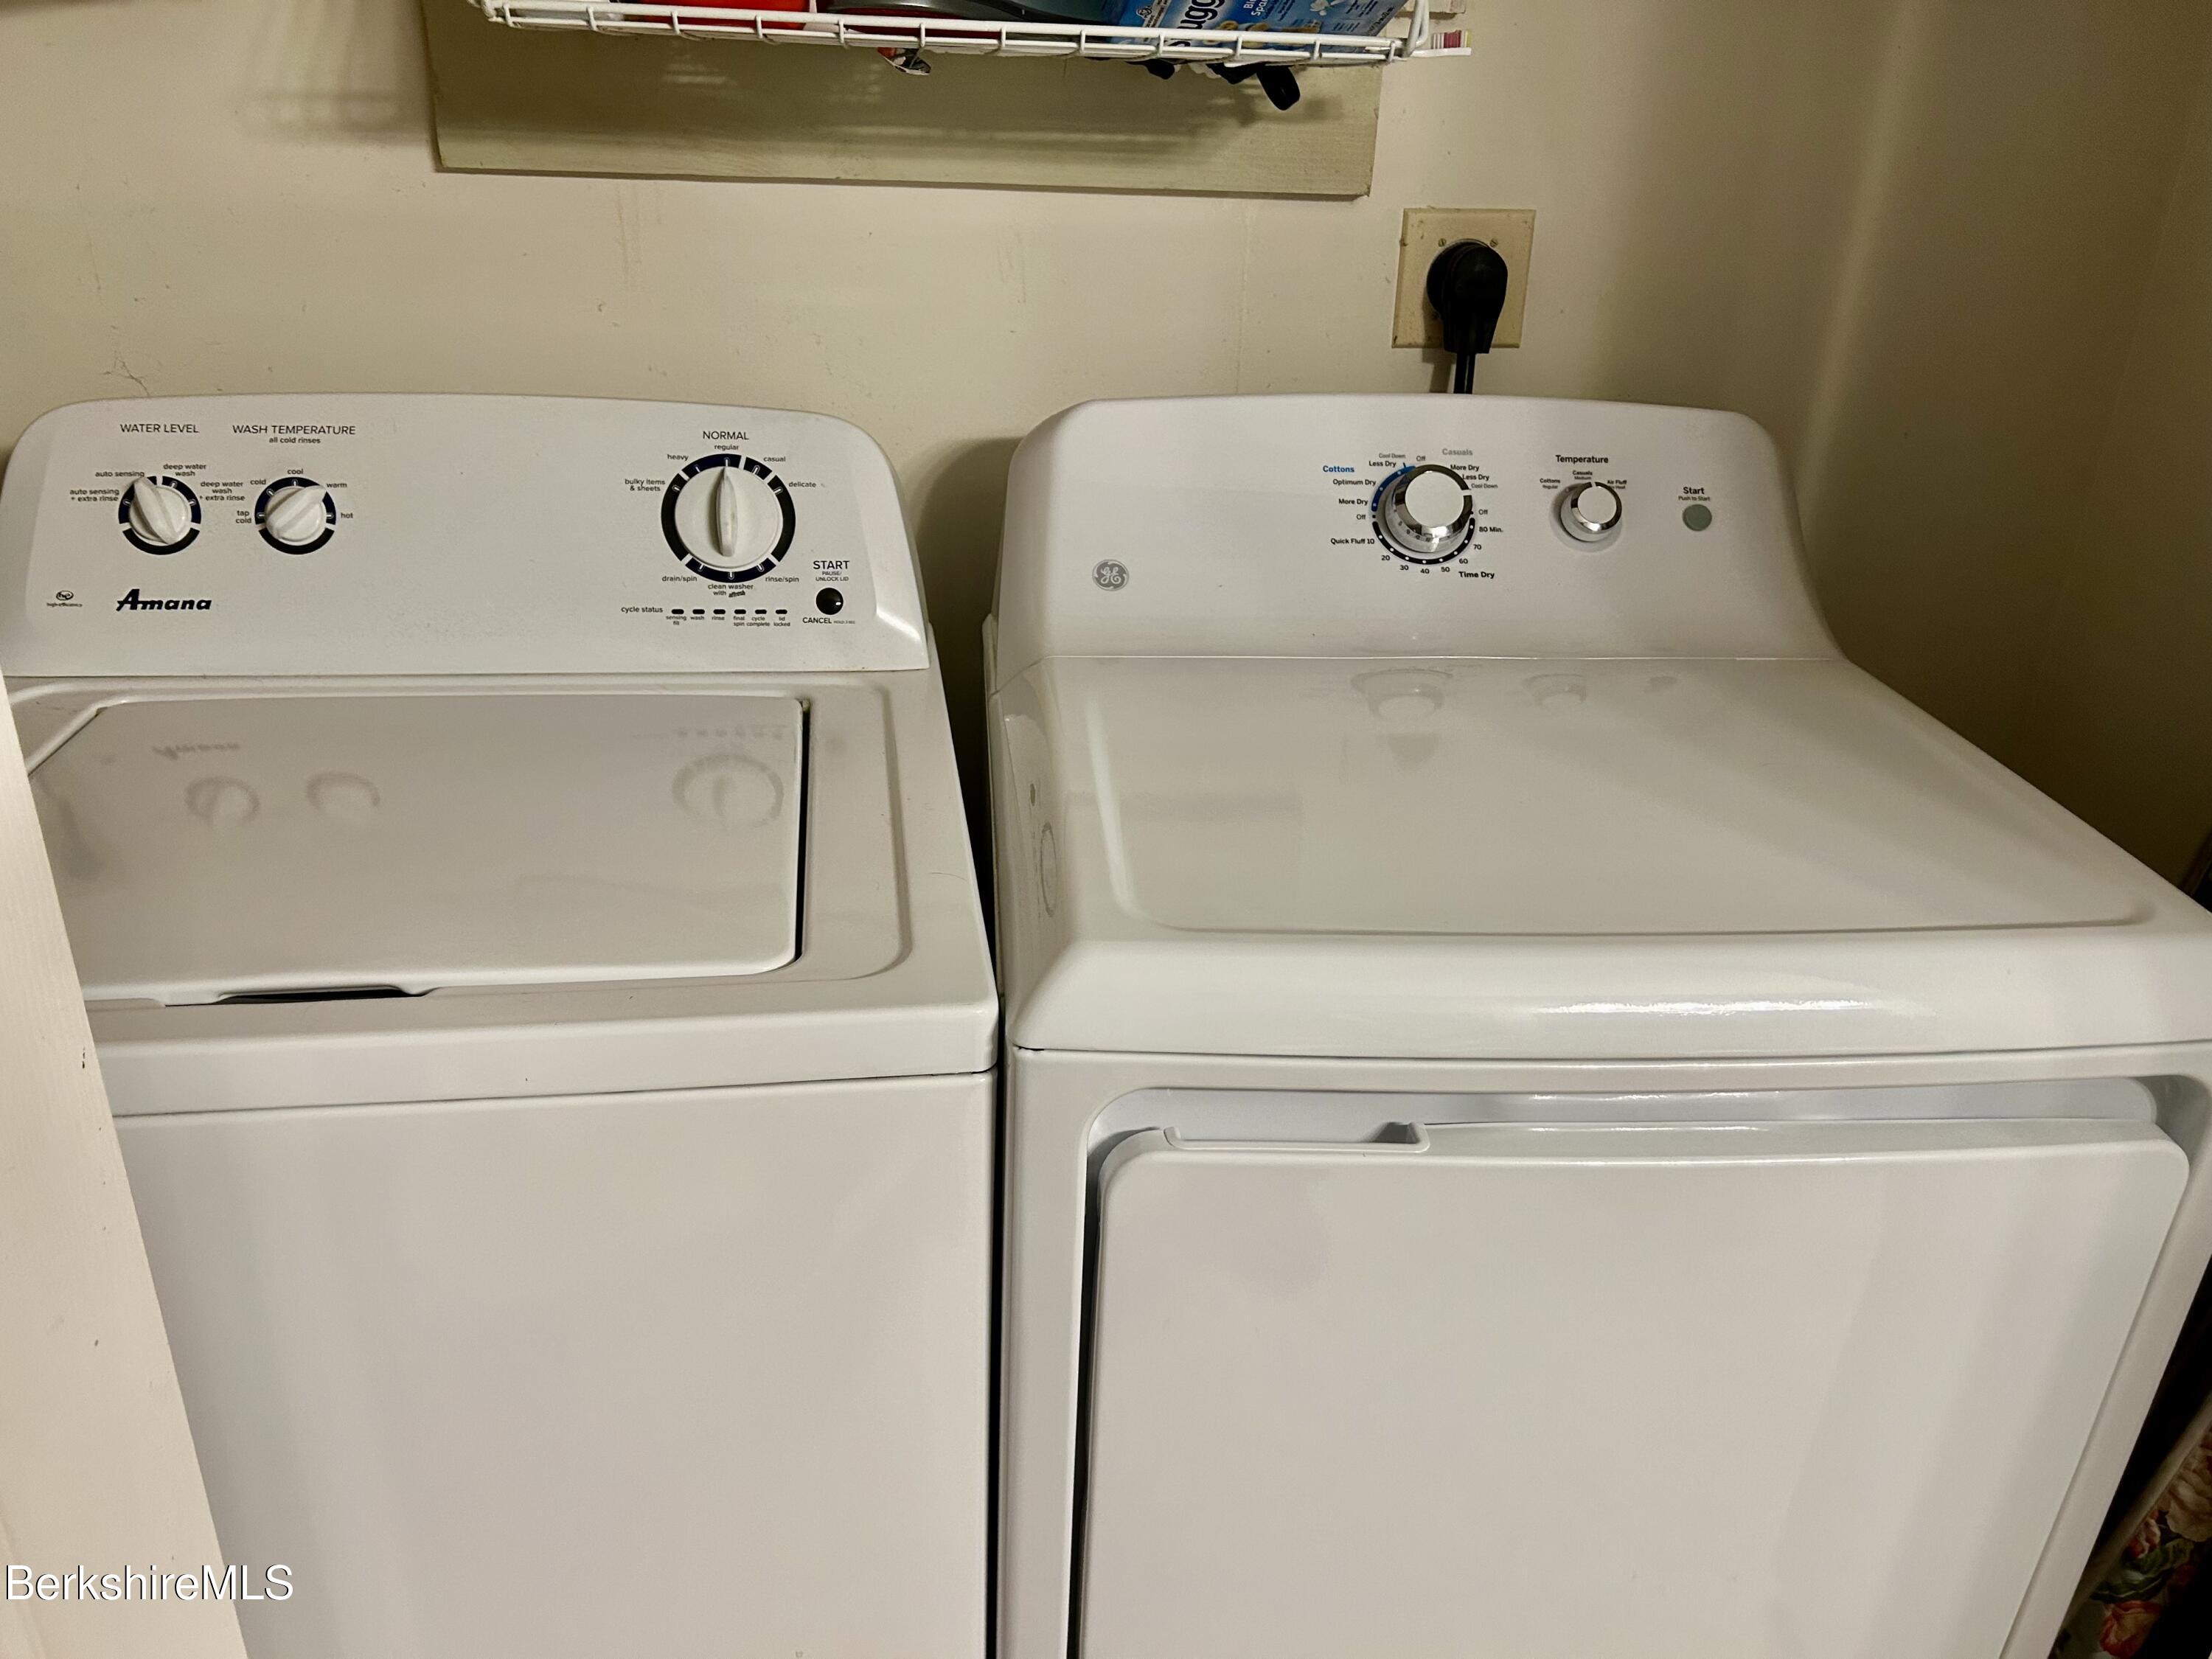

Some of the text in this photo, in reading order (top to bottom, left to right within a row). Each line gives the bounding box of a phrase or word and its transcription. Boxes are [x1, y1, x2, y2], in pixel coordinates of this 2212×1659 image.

[119, 423, 199, 434] WATER LEVEL
[232, 425, 356, 434] WASH TEMPERATURE
[703, 431, 749, 440] NORMAL
[667, 453, 689, 462] heavy
[1555, 454, 1609, 465] Temperature
[1478, 473, 1489, 481] Dry
[625, 479, 644, 487] bulky
[1683, 486, 1705, 495] Start
[813, 560, 850, 570] START
[1481, 571, 1495, 579] Dry
[116, 588, 212, 611] Amana
